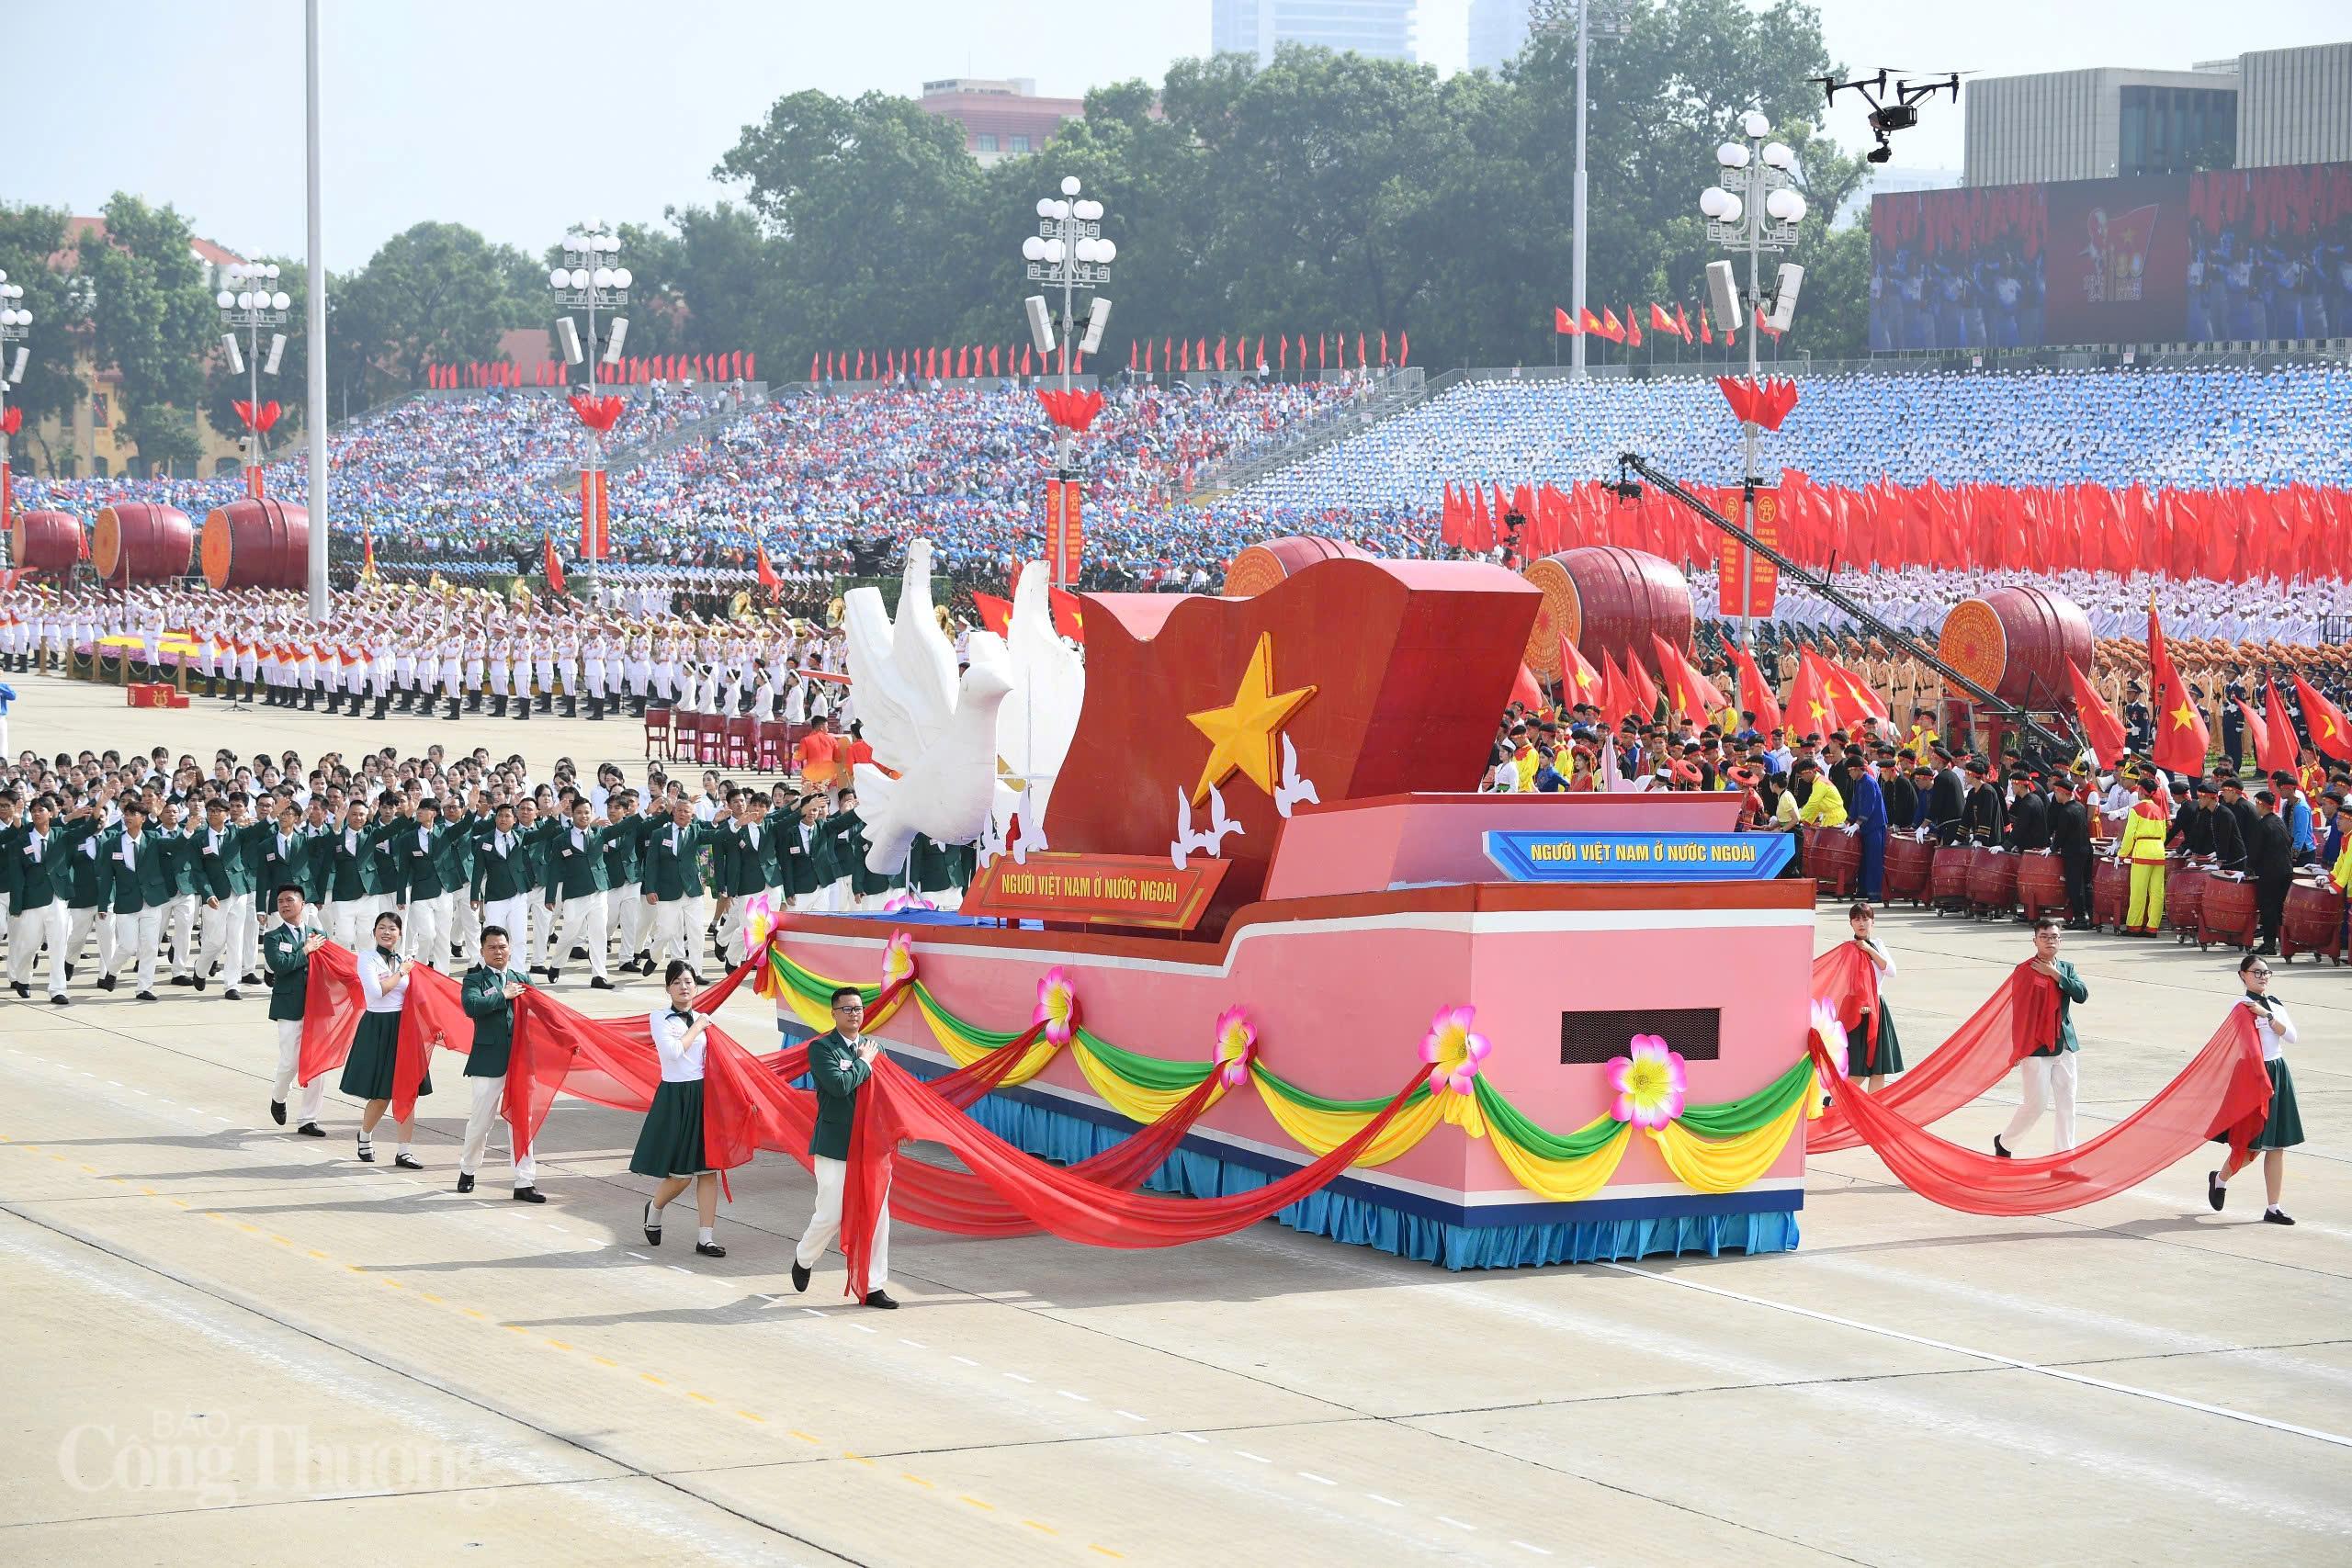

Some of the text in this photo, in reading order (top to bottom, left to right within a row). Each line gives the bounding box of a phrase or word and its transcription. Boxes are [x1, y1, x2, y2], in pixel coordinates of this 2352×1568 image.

[1531, 840, 1757, 864] NGƯỜI VIỆT NAM Ở NƯỚC NGOÀI
[1001, 870, 1177, 903] NGƯỜI VIỆT NAM Ở NƯỚC NGOÀI
